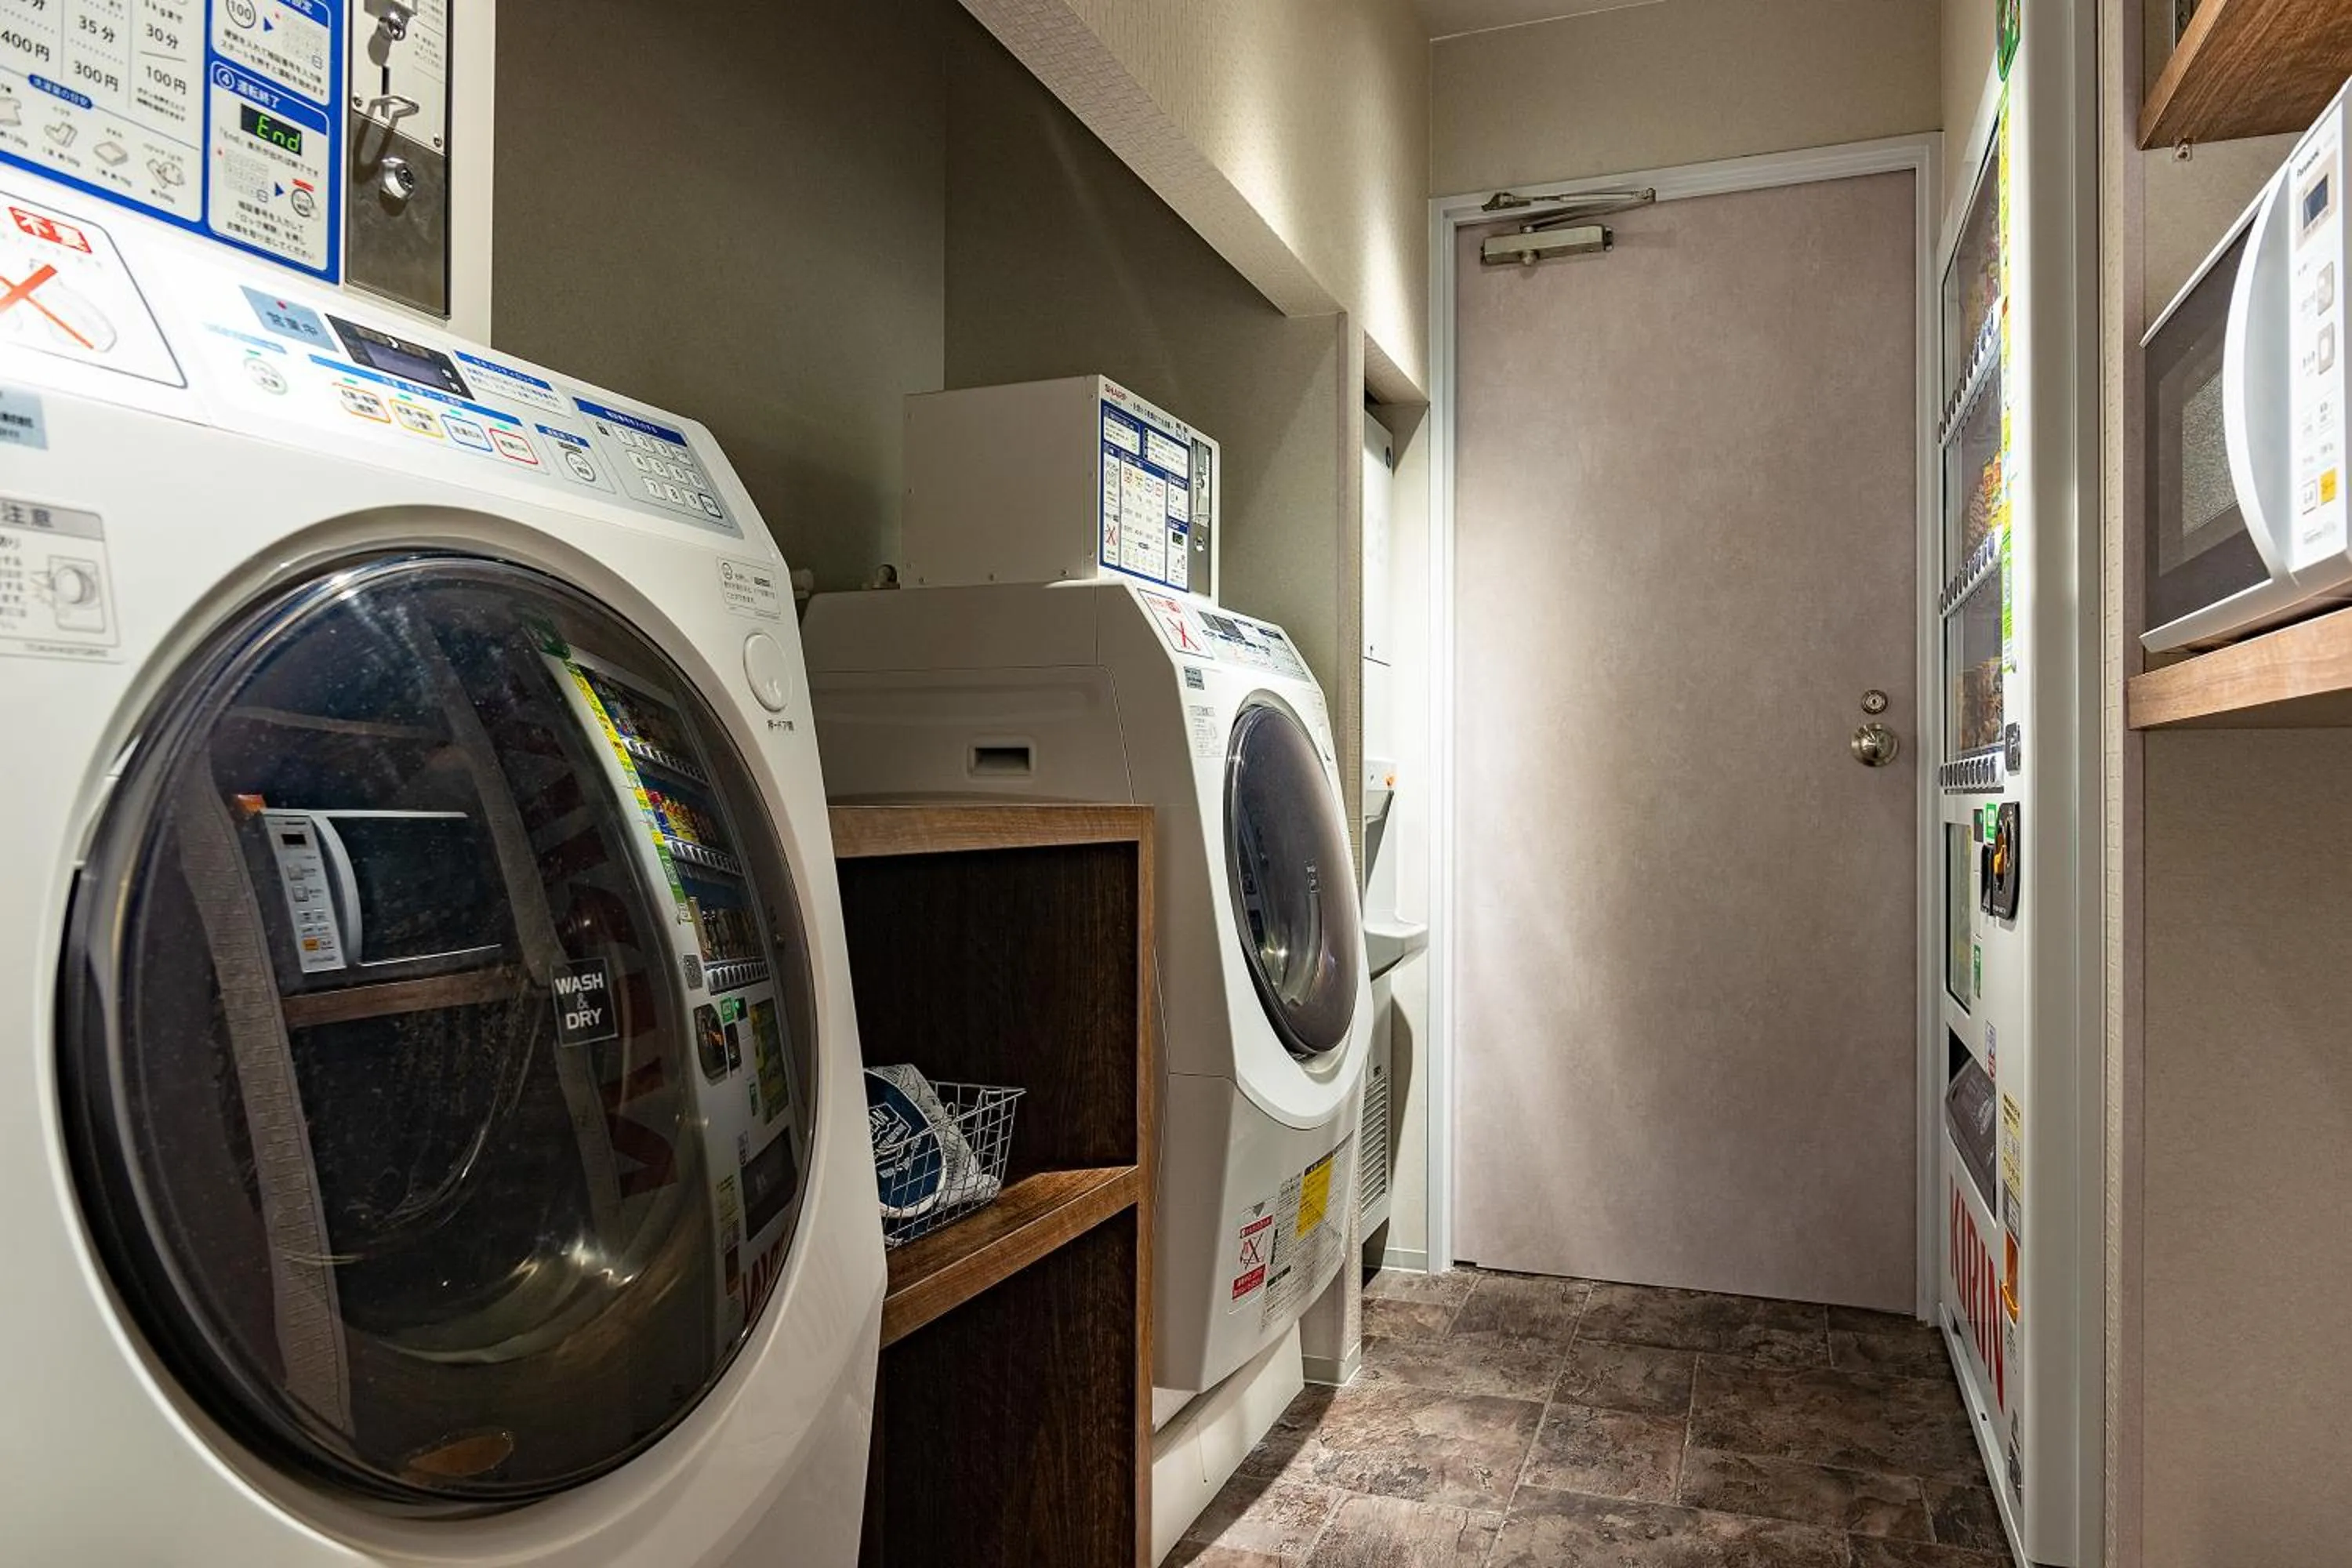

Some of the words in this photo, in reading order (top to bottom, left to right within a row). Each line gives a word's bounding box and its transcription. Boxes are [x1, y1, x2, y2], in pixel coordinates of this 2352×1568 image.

[230, 2, 252, 20] 100
[78, 15, 116, 44] 35分
[146, 23, 179, 50] 30分
[1, 30, 50, 62] 400円
[74, 60, 119, 93] 300円
[146, 66, 187, 96] 100円
[256, 112, 301, 152] End
[554, 972, 604, 995] WASH
[576, 992, 590, 1011] &
[565, 1007, 602, 1030] DRY
[1950, 1172, 2005, 1416] KIRIN
